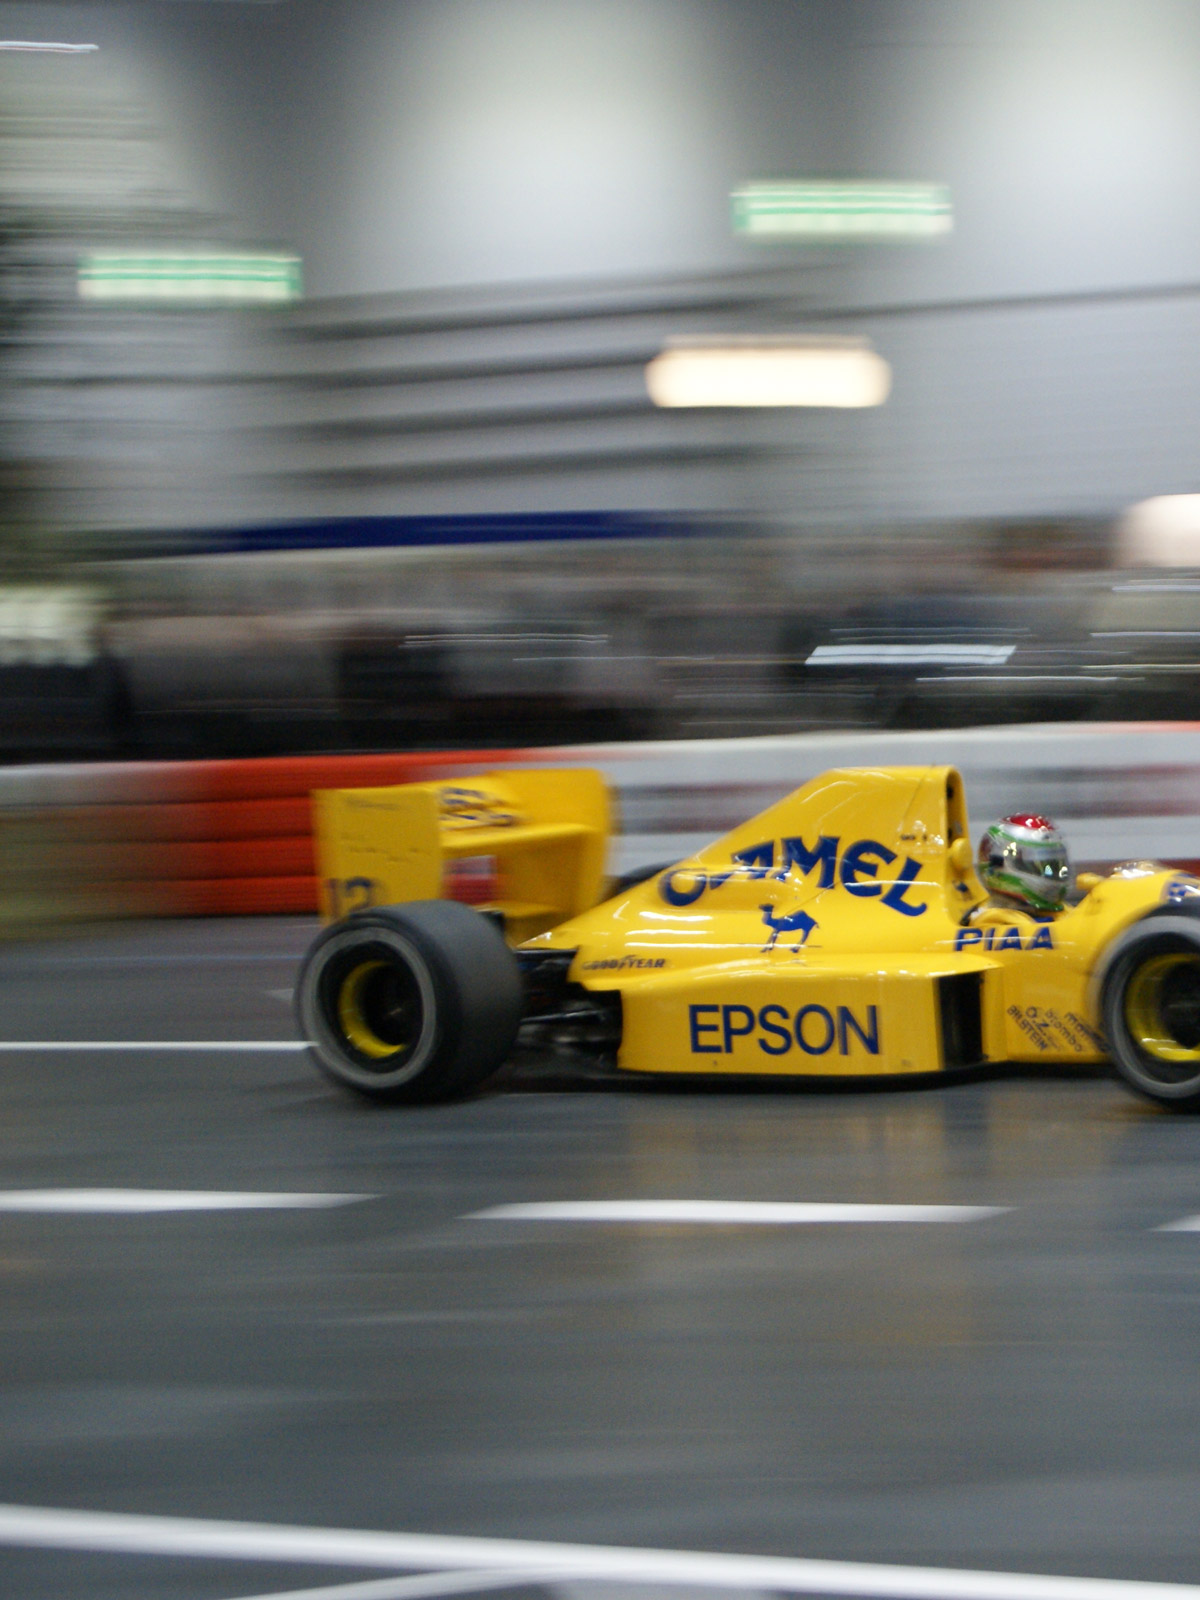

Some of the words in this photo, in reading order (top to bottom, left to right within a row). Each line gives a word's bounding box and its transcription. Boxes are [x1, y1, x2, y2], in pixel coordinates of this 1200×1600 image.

[658, 836, 926, 917] CAMEL
[954, 926, 1054, 951] PIAA
[689, 1003, 880, 1056] EPSON
